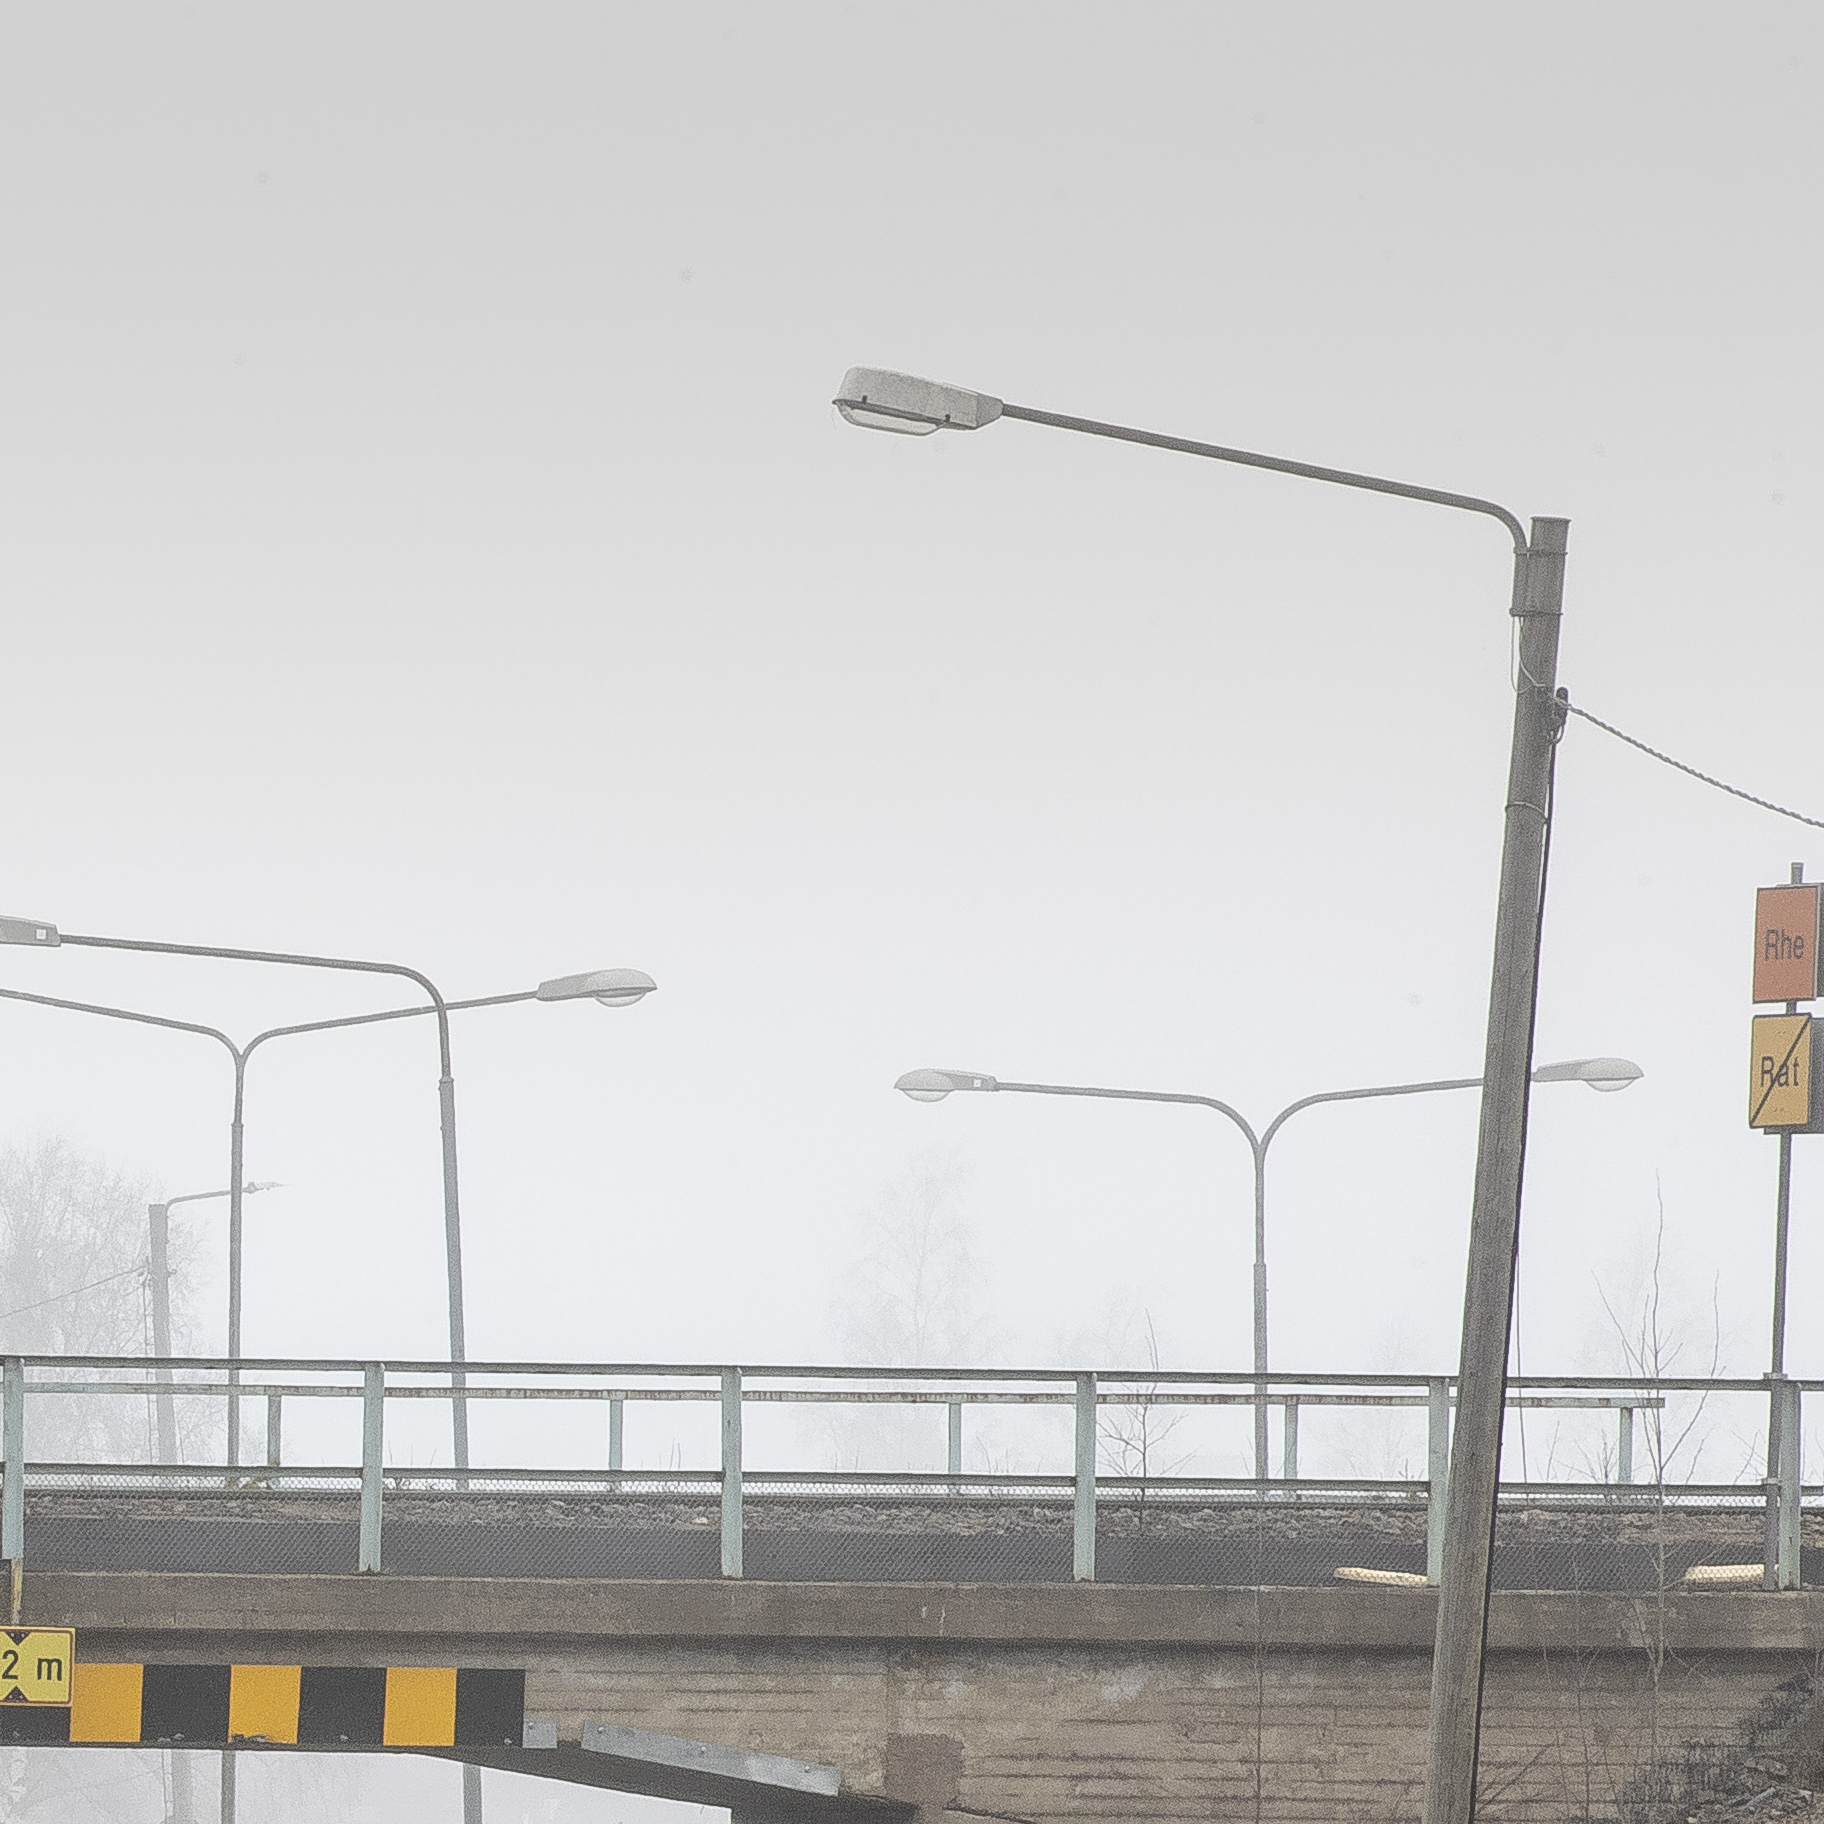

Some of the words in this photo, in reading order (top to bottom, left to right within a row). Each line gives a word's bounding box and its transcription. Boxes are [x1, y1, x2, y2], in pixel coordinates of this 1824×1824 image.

[1764, 928, 1805, 962] Rhe
[1759, 1056, 1801, 1089] Rat
[36, 1657, 63, 1681] m
